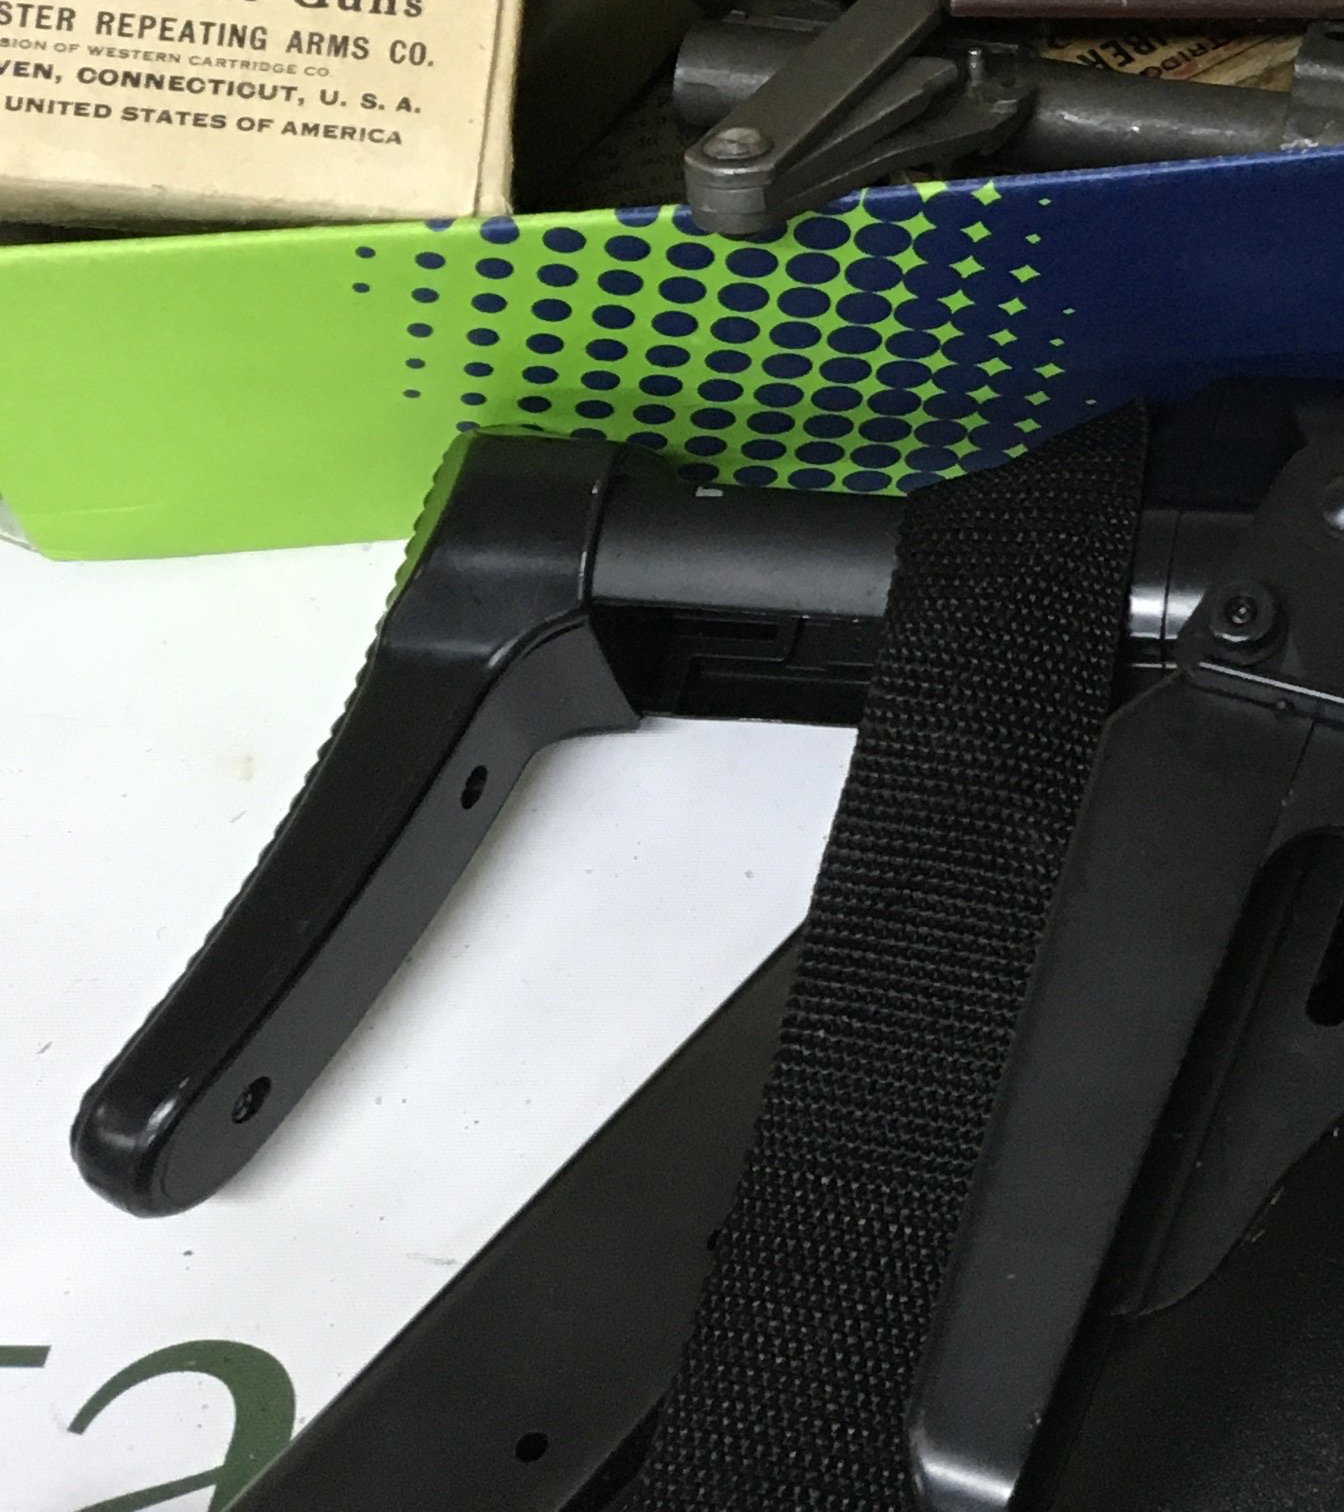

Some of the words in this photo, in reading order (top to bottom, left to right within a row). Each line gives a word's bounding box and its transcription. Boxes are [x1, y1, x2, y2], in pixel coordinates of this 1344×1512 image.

[0, 0, 76, 31] STER
[96, 10, 268, 51] REPEATING
[286, 30, 370, 60] ARMS
[389, 39, 434, 67] CO.
[53, 42, 80, 53] OF
[87, 45, 181, 63] WESTERN
[189, 55, 298, 75] CARTRIDGE
[77, 67, 304, 106] CONNECTICUT,
[5, 95, 112, 119] UNITED
[121, 106, 227, 130] STATES
[236, 117, 274, 133] OF
[281, 121, 402, 145] AMERICA
